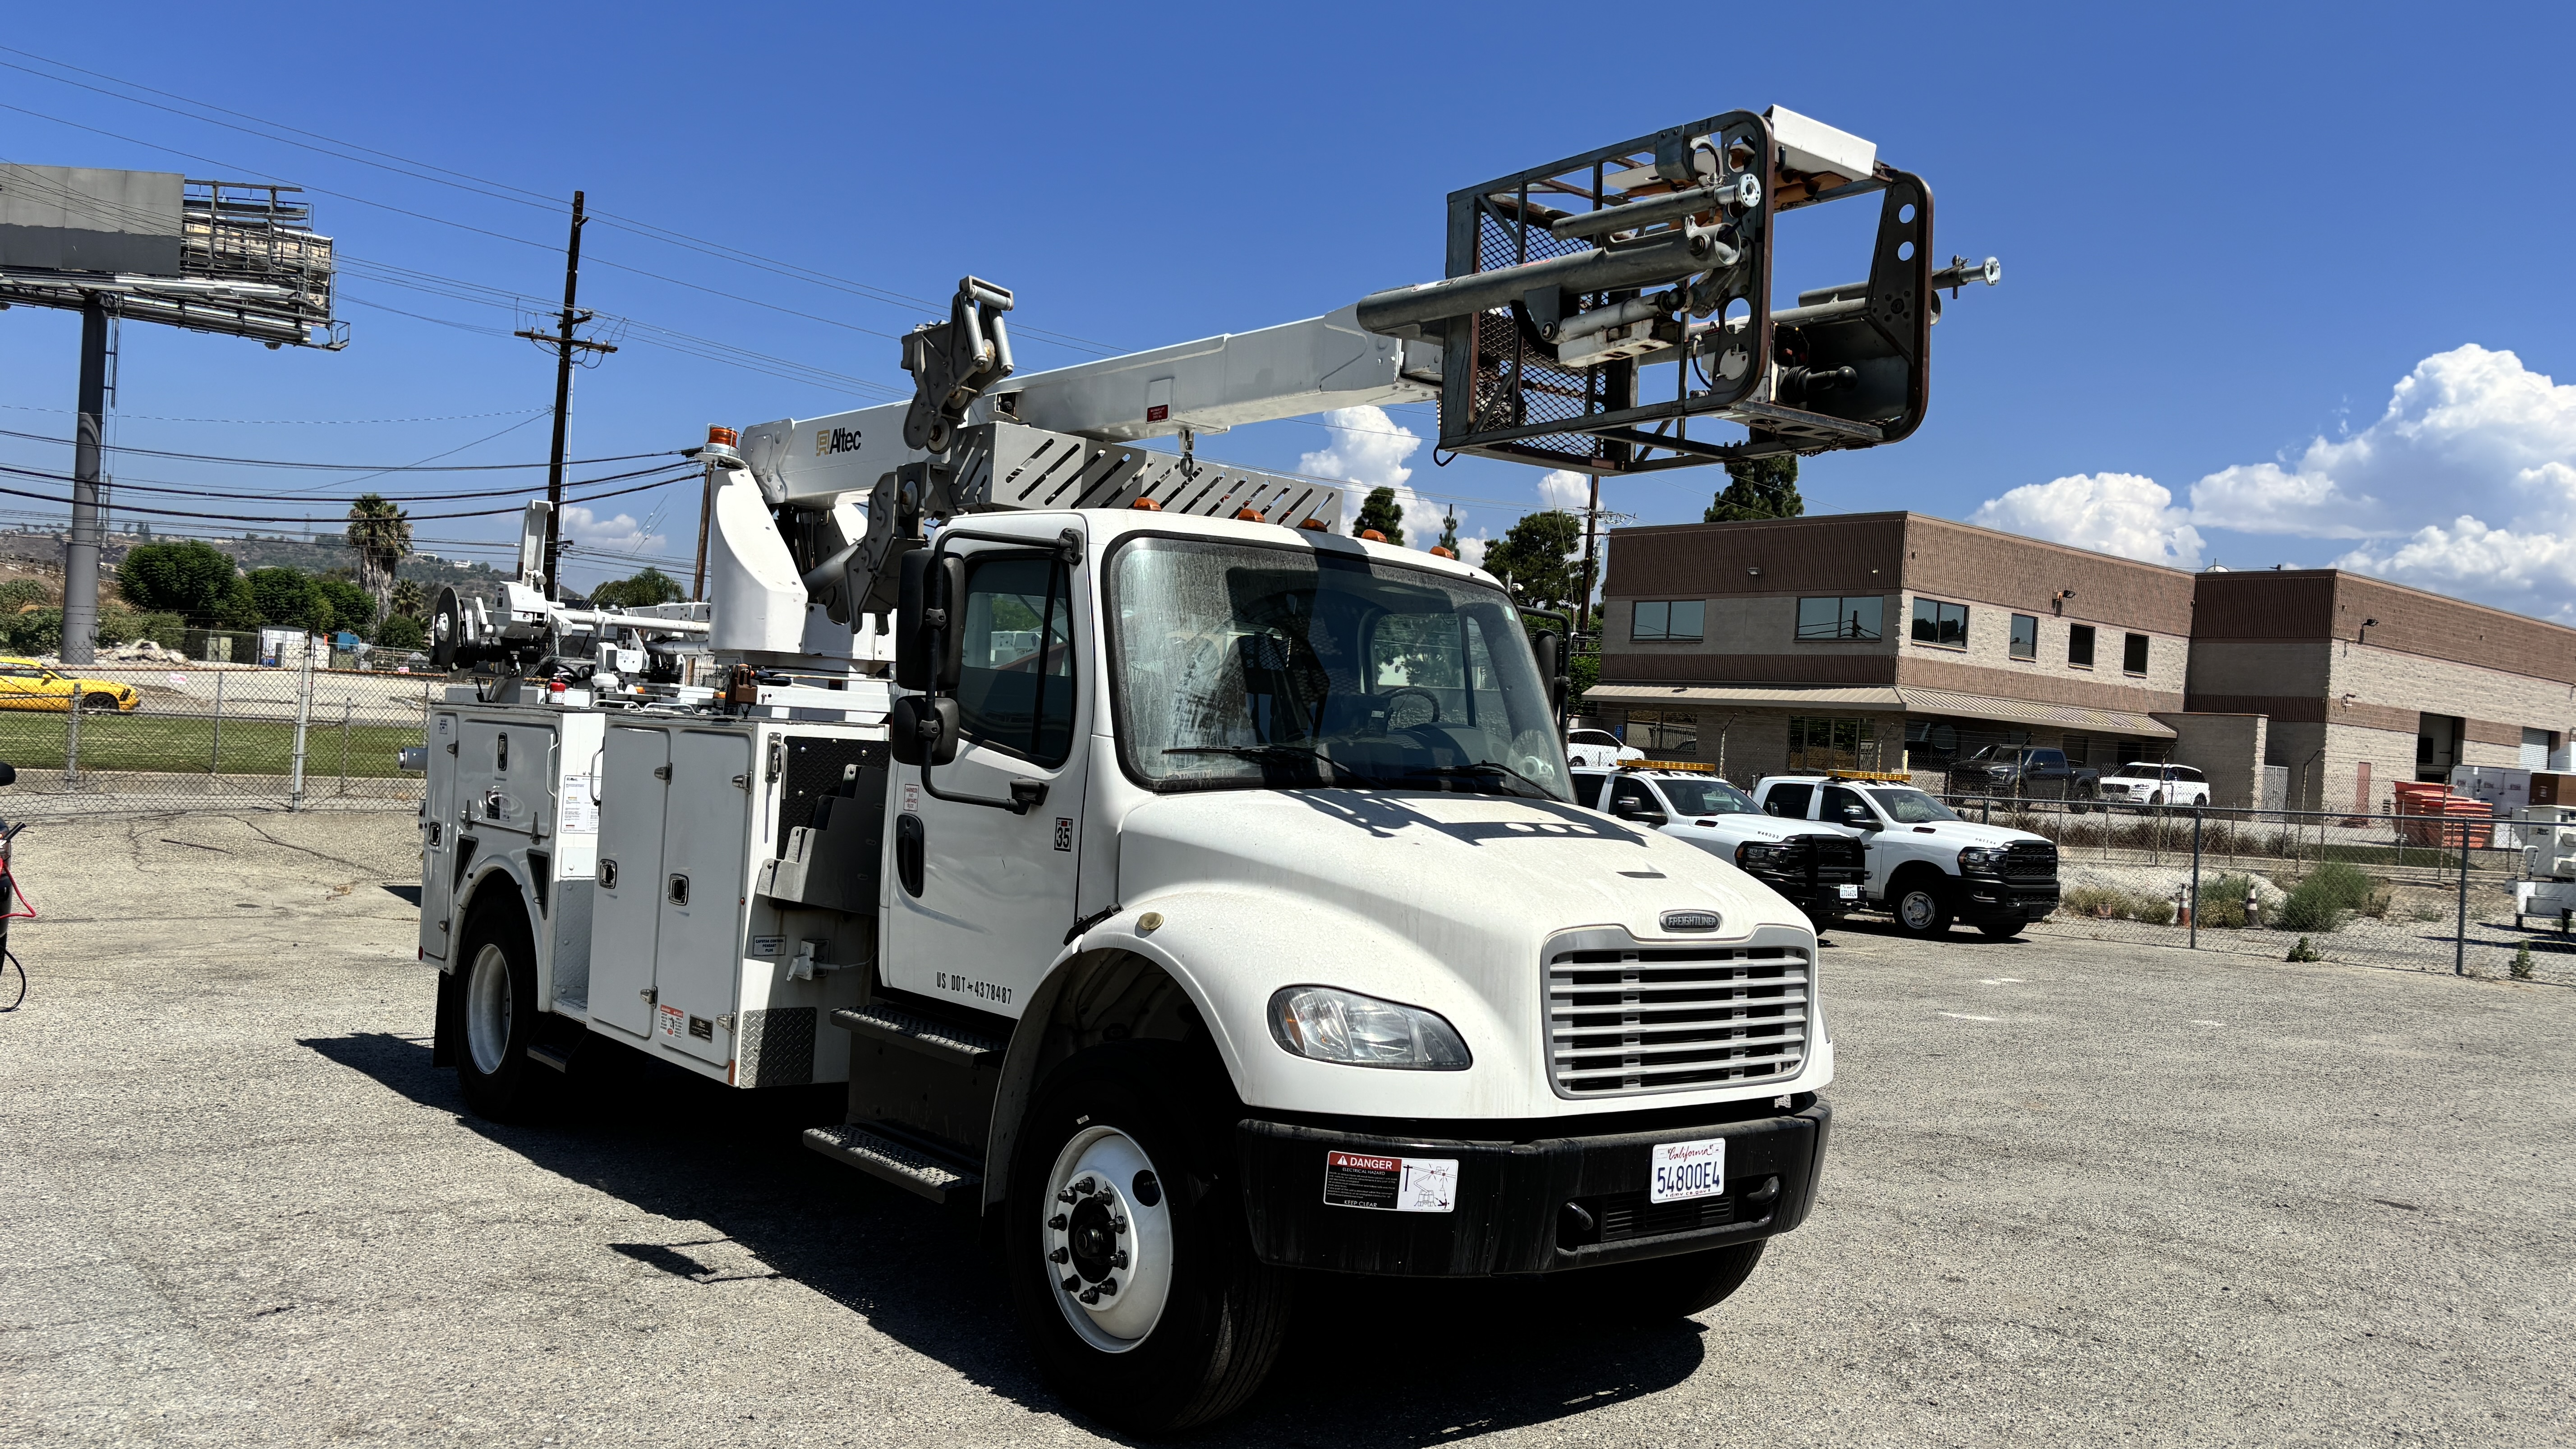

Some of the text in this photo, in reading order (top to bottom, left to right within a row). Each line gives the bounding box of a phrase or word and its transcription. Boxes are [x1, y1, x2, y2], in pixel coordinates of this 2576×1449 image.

[829, 428, 861, 454] Altec
[1056, 827, 1070, 848] 35
[1669, 916, 1716, 926] FREIGHTLINER
[937, 971, 946, 989] US
[1350, 1157, 1393, 1169] DANGER
[1669, 1146, 1712, 1162] California
[1657, 1161, 1720, 1194] 54800E4
